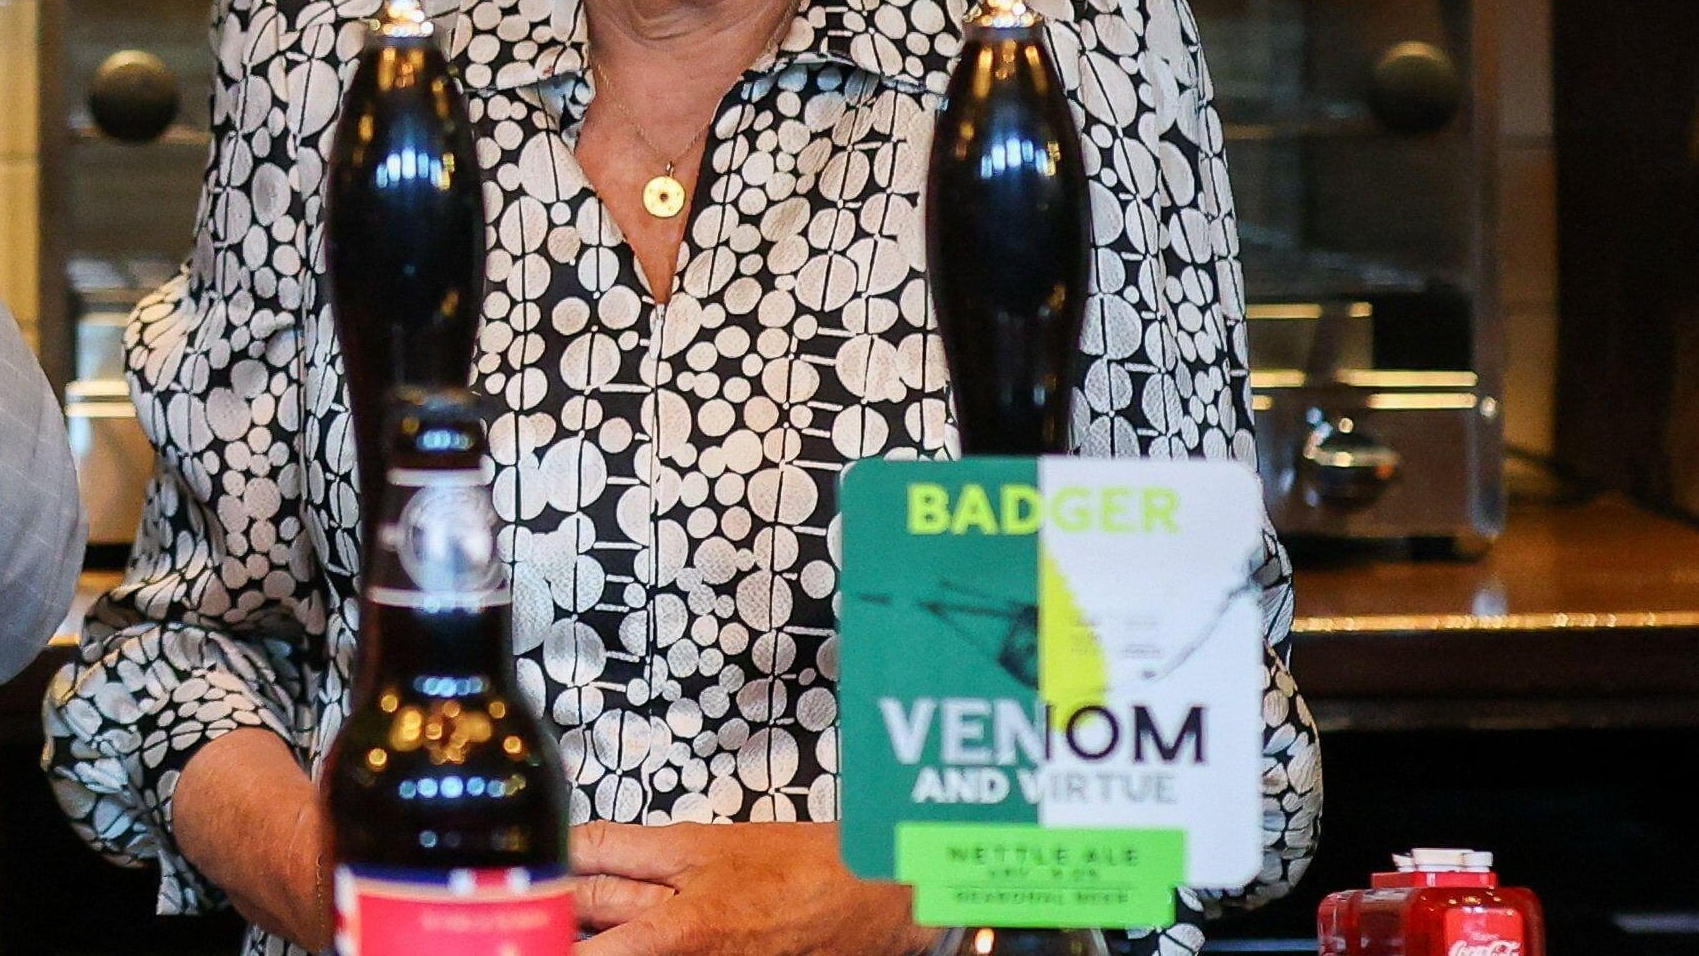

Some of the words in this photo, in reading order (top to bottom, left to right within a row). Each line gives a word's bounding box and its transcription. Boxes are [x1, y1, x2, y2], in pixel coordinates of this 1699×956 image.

[907, 483, 1181, 535] BADGER
[879, 697, 1209, 766] VENOM
[911, 767, 1011, 805] AND
[1017, 767, 1179, 805] VIRTUE
